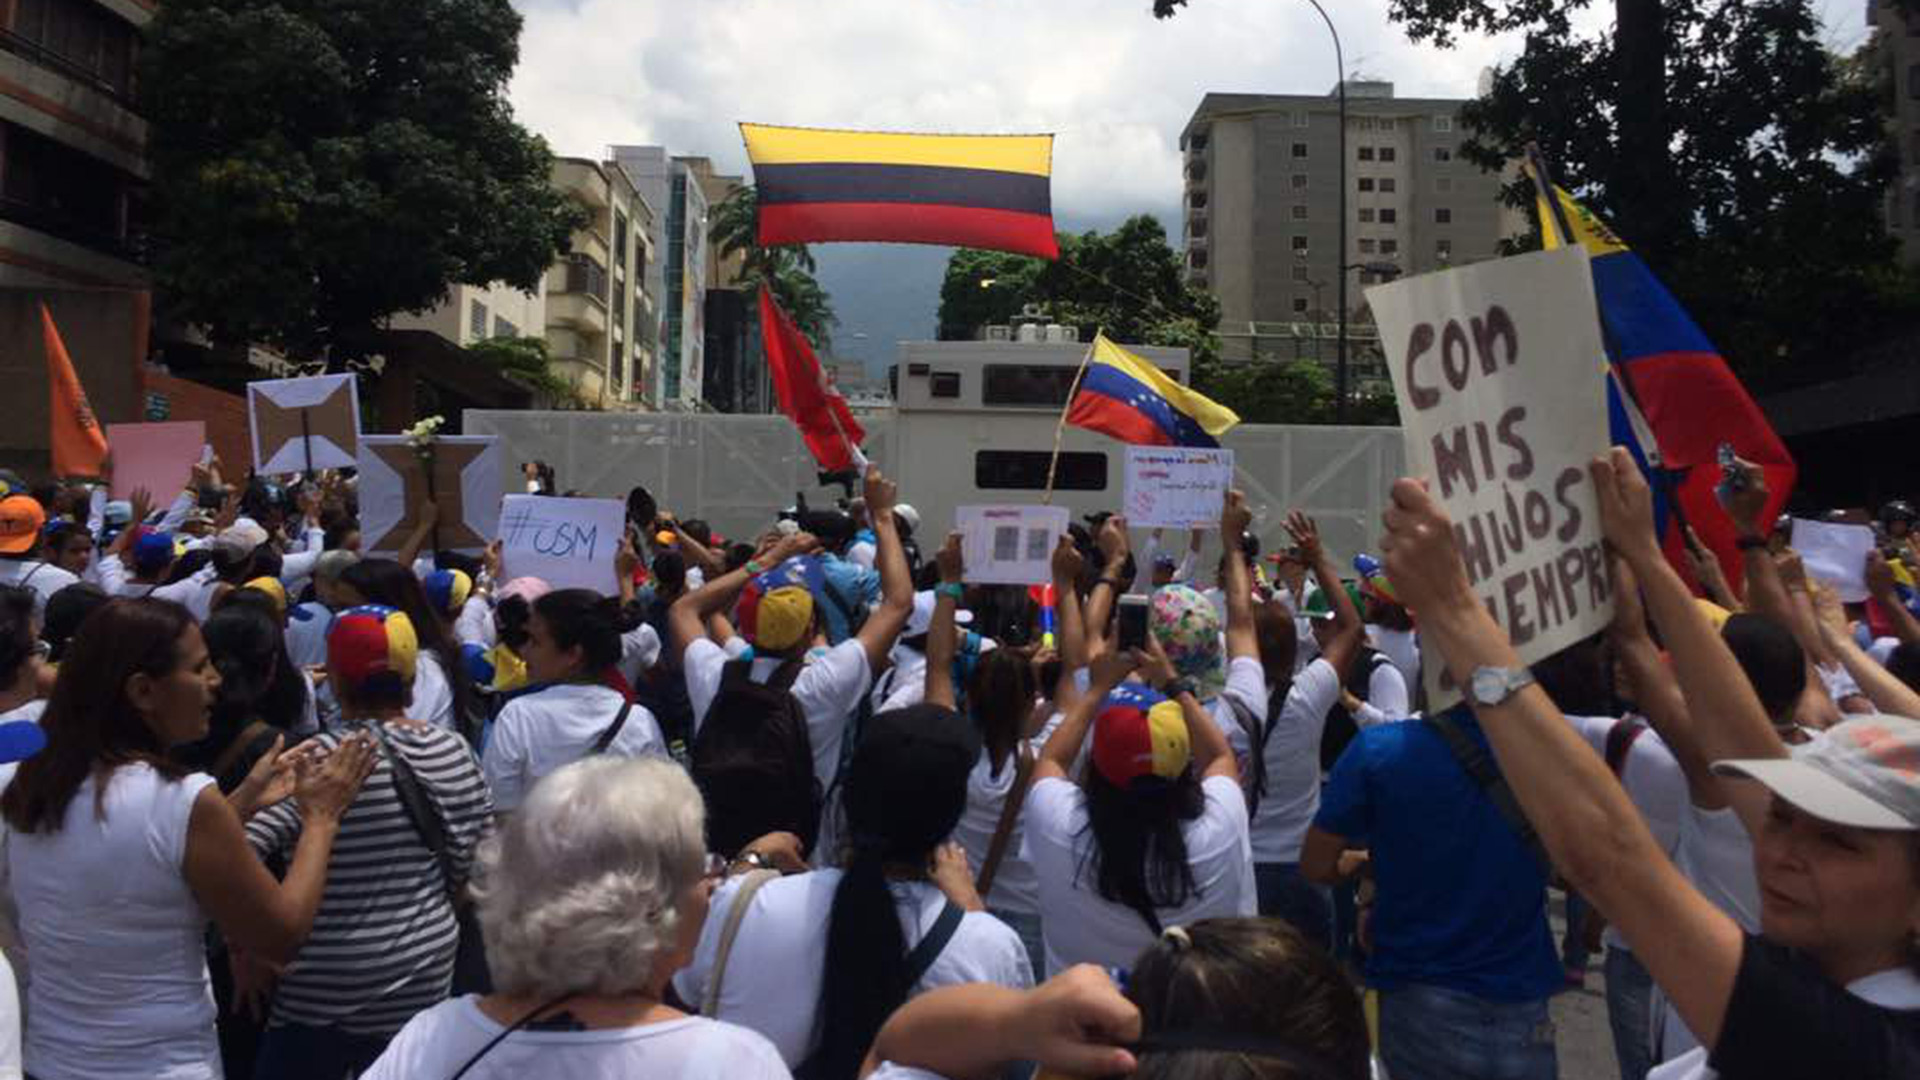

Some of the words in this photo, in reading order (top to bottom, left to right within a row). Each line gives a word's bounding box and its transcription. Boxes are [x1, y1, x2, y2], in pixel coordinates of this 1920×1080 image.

[1431, 406, 1534, 499] MIS
[505, 503, 598, 563] #USM
[1453, 467, 1582, 587] HIJOS
